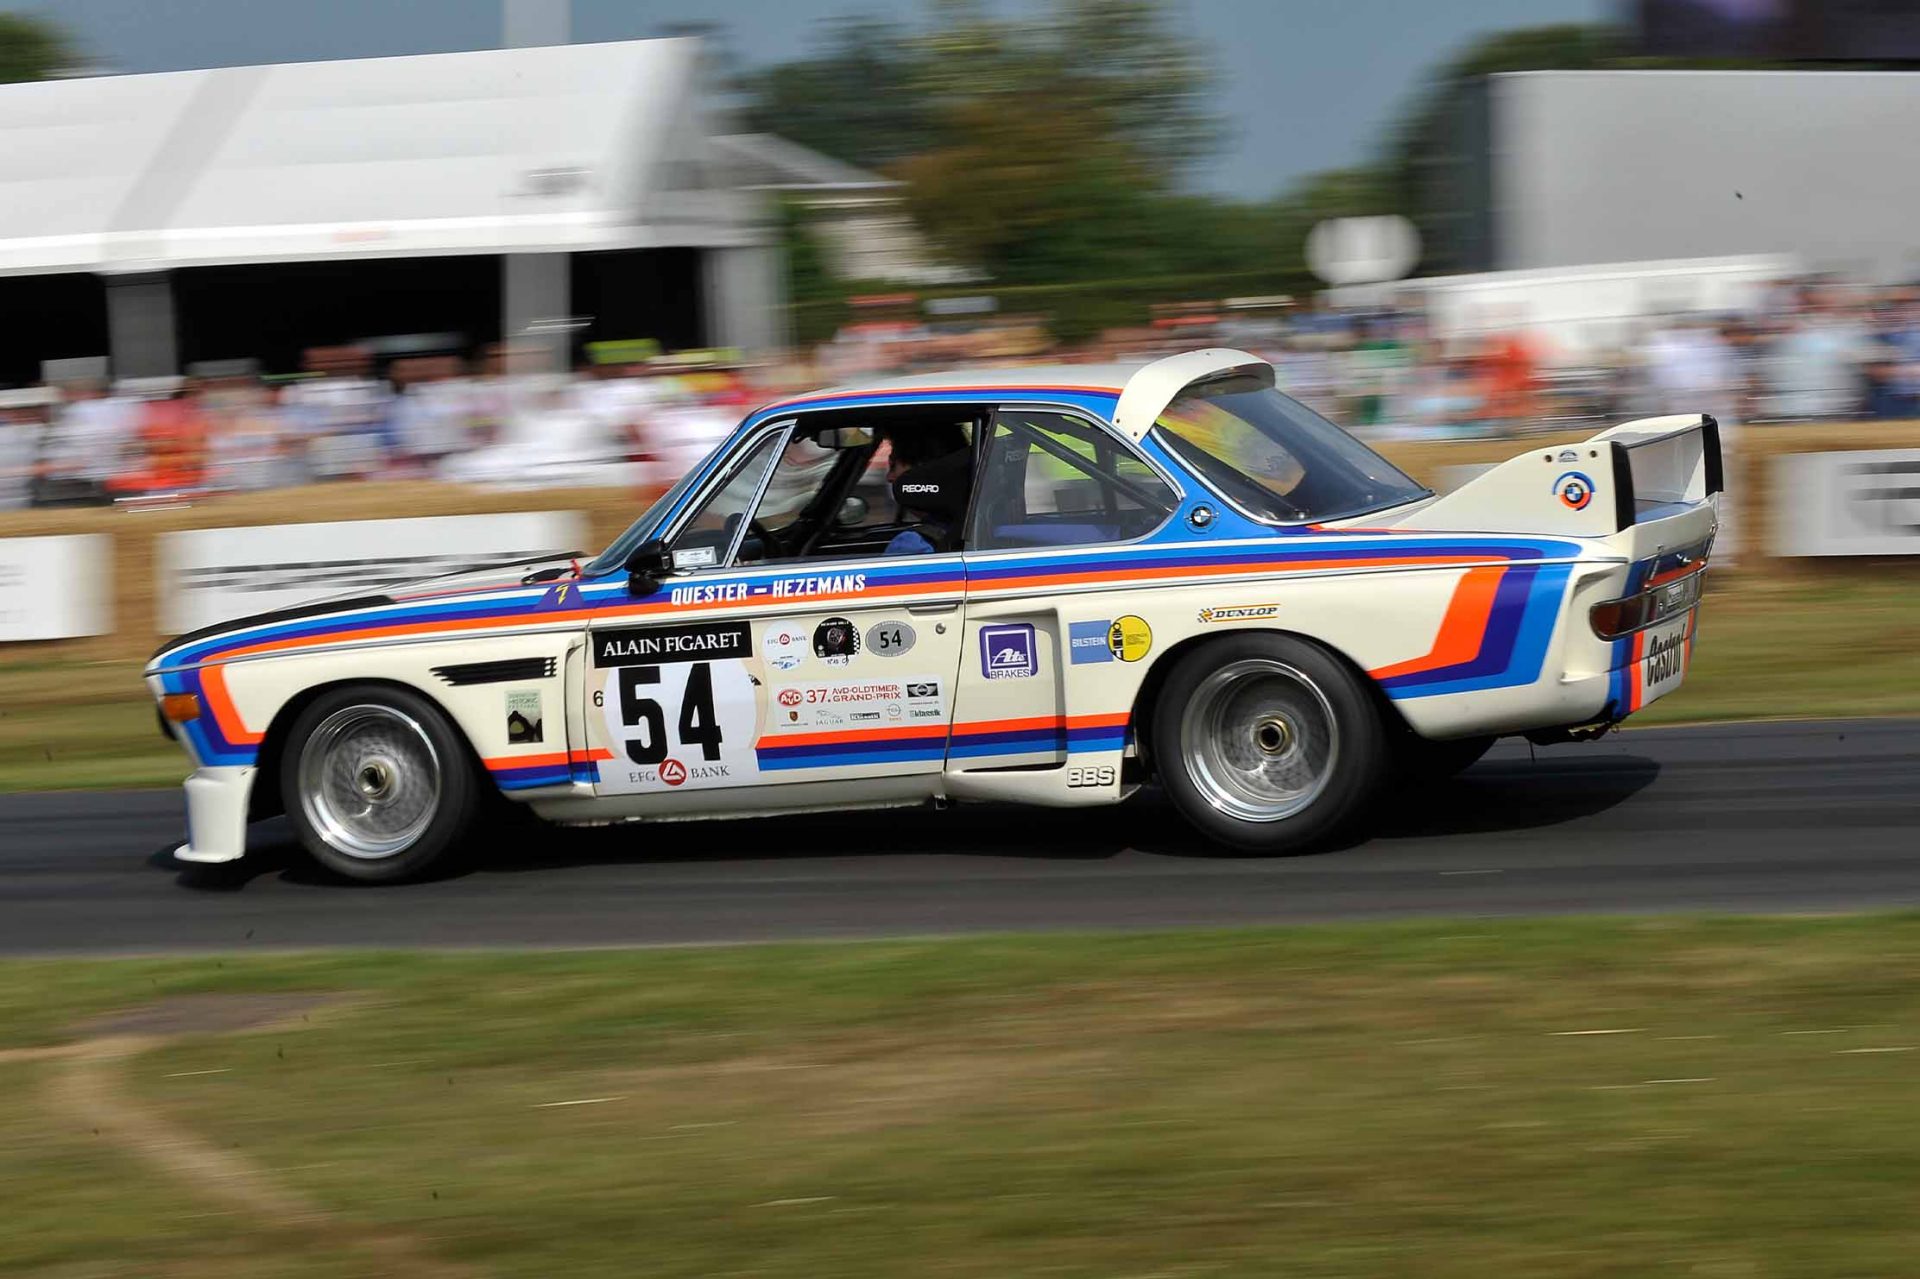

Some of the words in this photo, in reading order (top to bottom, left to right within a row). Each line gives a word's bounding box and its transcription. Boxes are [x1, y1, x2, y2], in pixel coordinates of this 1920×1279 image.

[902, 484, 940, 493] RECARO
[671, 583, 747, 606] QUESTER
[772, 574, 866, 598] HEZEMANS
[1214, 606, 1278, 618] DUNLOP
[603, 638, 661, 657] ALAIN
[666, 631, 741, 652] FIGARET
[879, 629, 903, 649] 54
[1071, 635, 1107, 648] BILSTEIN
[990, 668, 1030, 679] BRAKES
[593, 690, 604, 707] 6
[806, 688, 832, 704] 37.
[833, 691, 901, 703] GRAND-PRIX
[618, 662, 723, 765] 54
[629, 770, 656, 783] EFG
[690, 764, 730, 779] BANK
[1066, 765, 1115, 788] BBS
